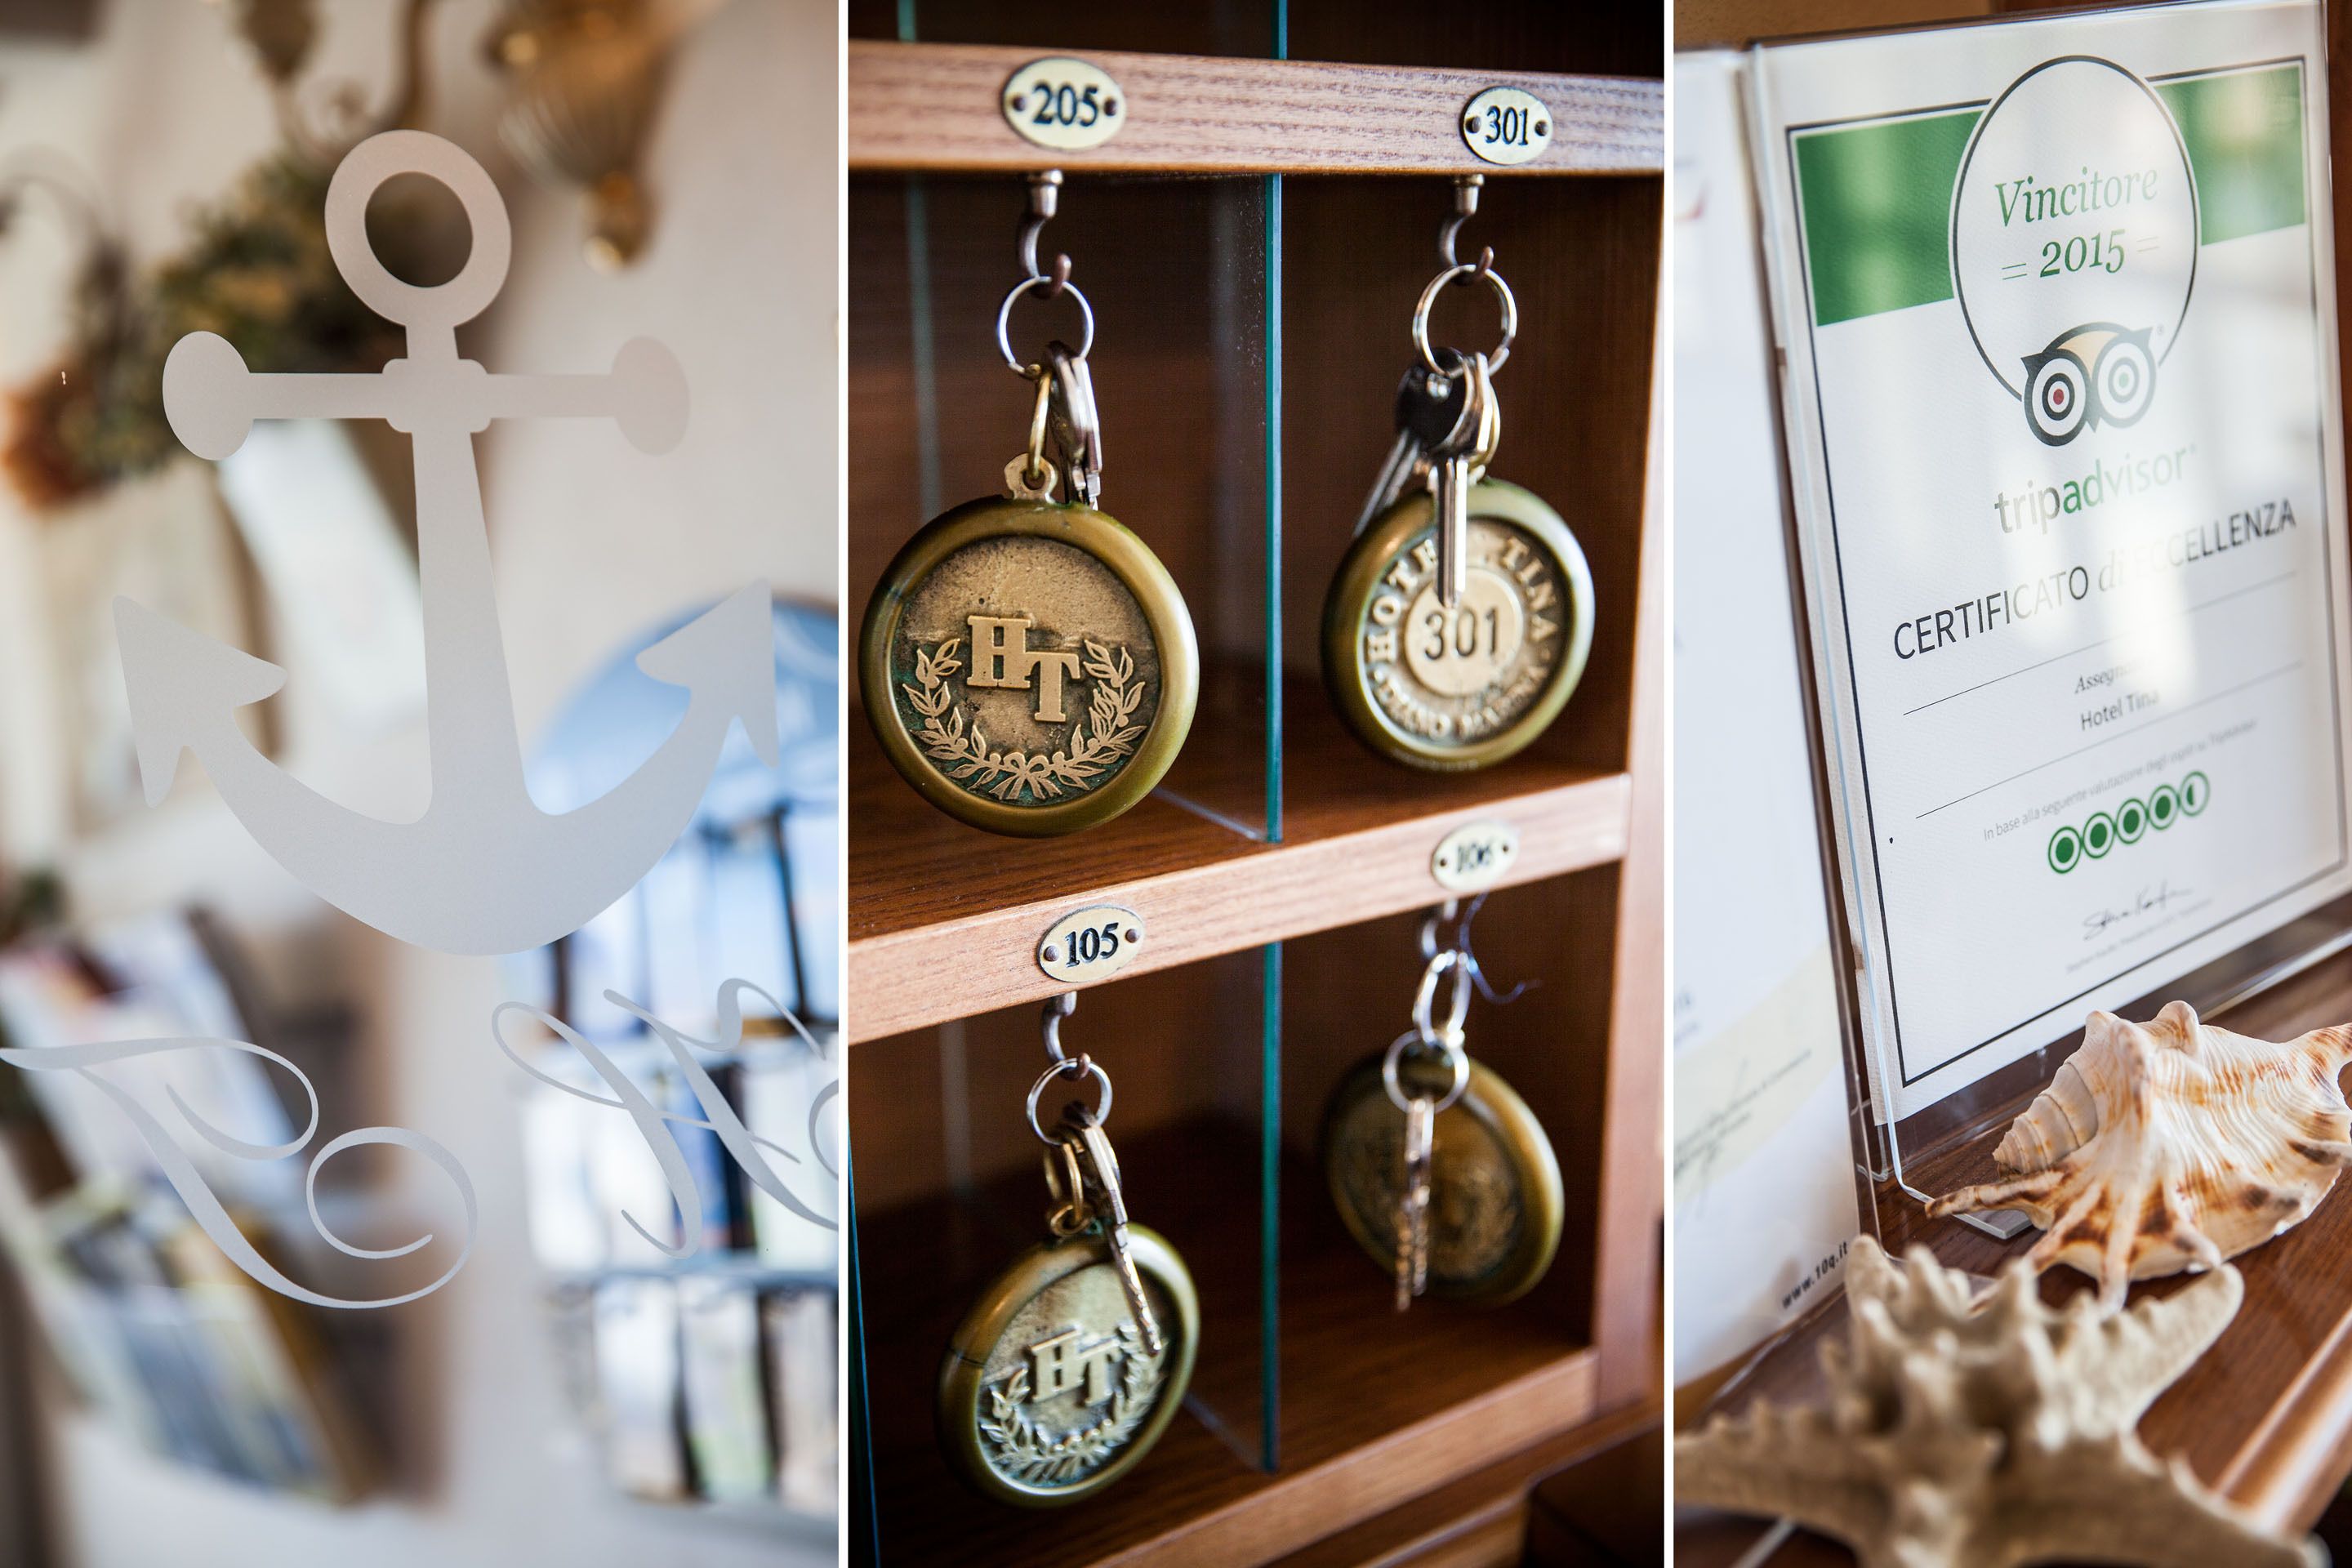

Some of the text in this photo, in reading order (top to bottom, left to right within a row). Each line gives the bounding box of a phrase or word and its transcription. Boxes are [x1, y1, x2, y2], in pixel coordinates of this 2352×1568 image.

[1032, 83, 1099, 127] 205
[1485, 105, 1528, 146] 301
[1994, 166, 2158, 228] Vincitore
[2040, 229, 2126, 278] 2015
[1994, 446, 2187, 534] tripadvisor
[1367, 537, 1558, 664] HOTE TINA
[1893, 497, 2297, 660] CERTIFICATO di ECCELLENZA
[1424, 607, 1498, 661] 301
[967, 615, 1081, 723] HT
[2080, 689, 2161, 732] Hotel Tina
[1983, 828, 1995, 842] In
[1996, 817, 2020, 837] base
[1064, 922, 1120, 968] 105
[1782, 1240, 1848, 1309] www.10q.it
[1029, 1325, 1122, 1407] HT
